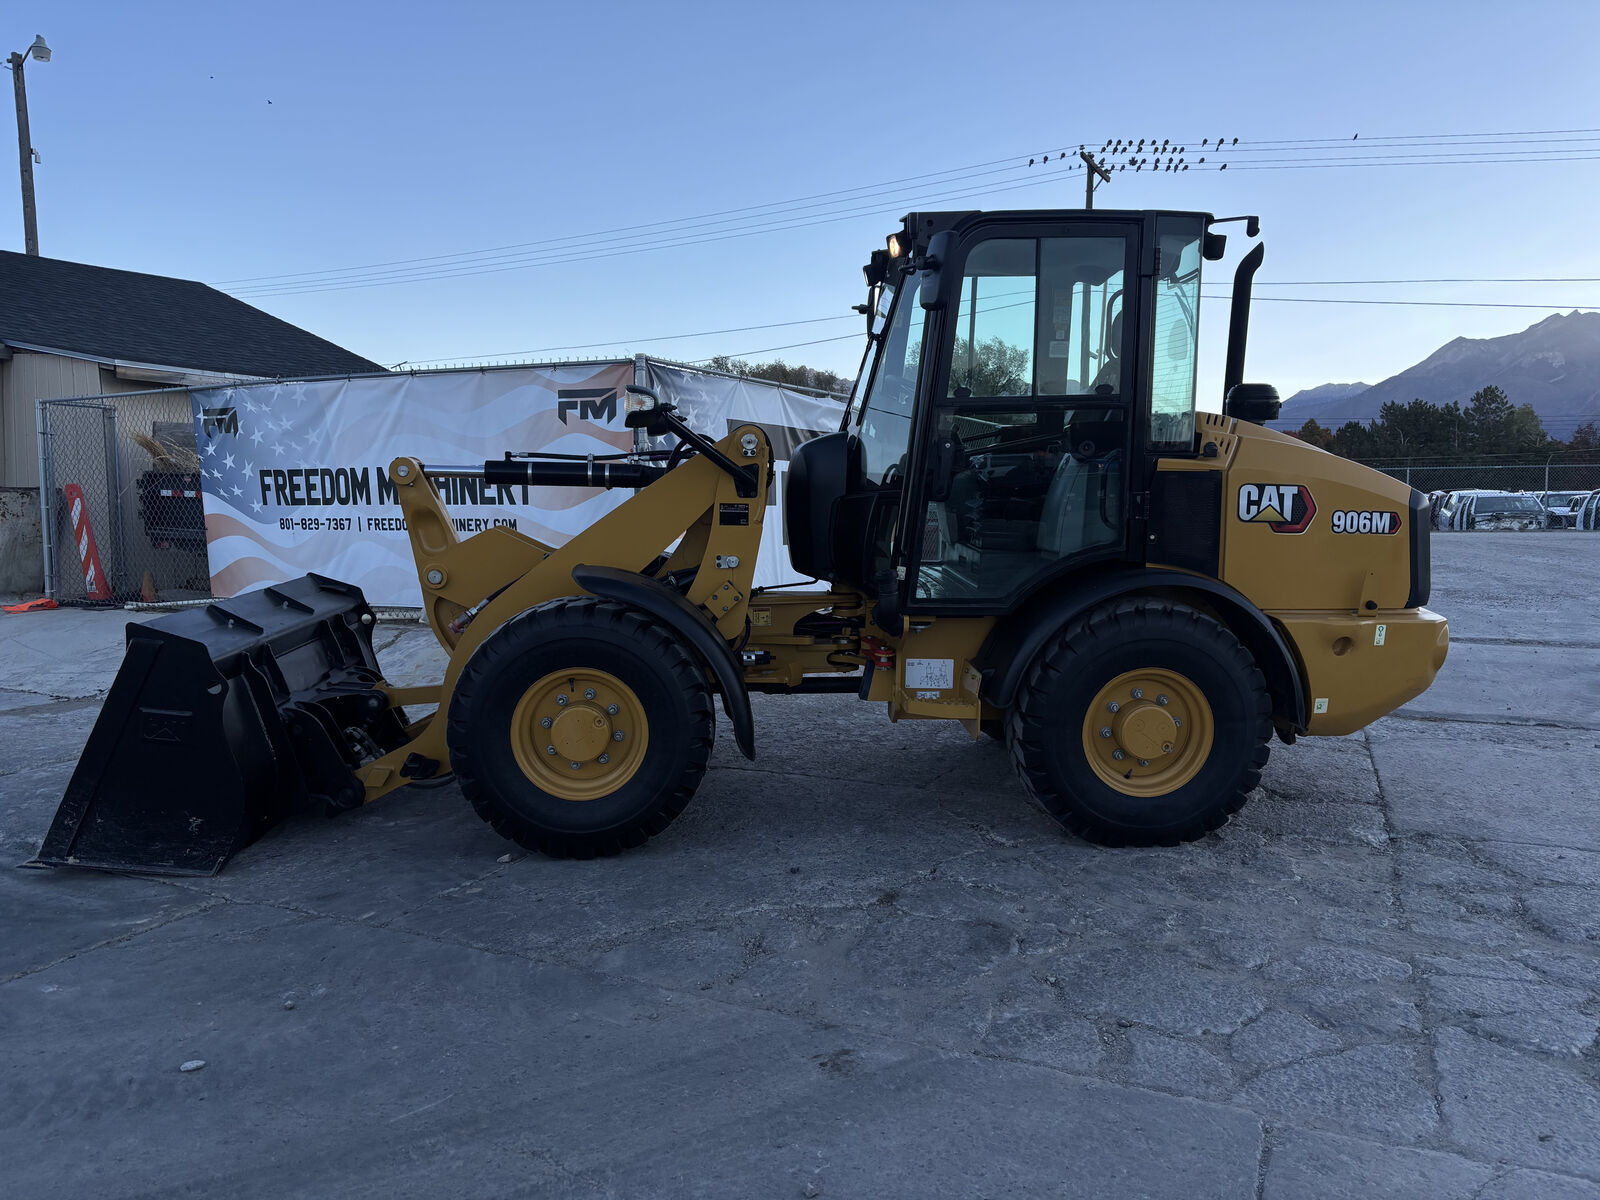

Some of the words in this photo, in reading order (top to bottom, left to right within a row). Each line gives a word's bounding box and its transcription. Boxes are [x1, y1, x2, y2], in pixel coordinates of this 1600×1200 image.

[557, 387, 617, 426] FM
[259, 467, 372, 506] FREEDOM
[1239, 484, 1298, 522] CAT
[280, 518, 352, 531] 801-829-7367
[1332, 510, 1391, 534] 906M
